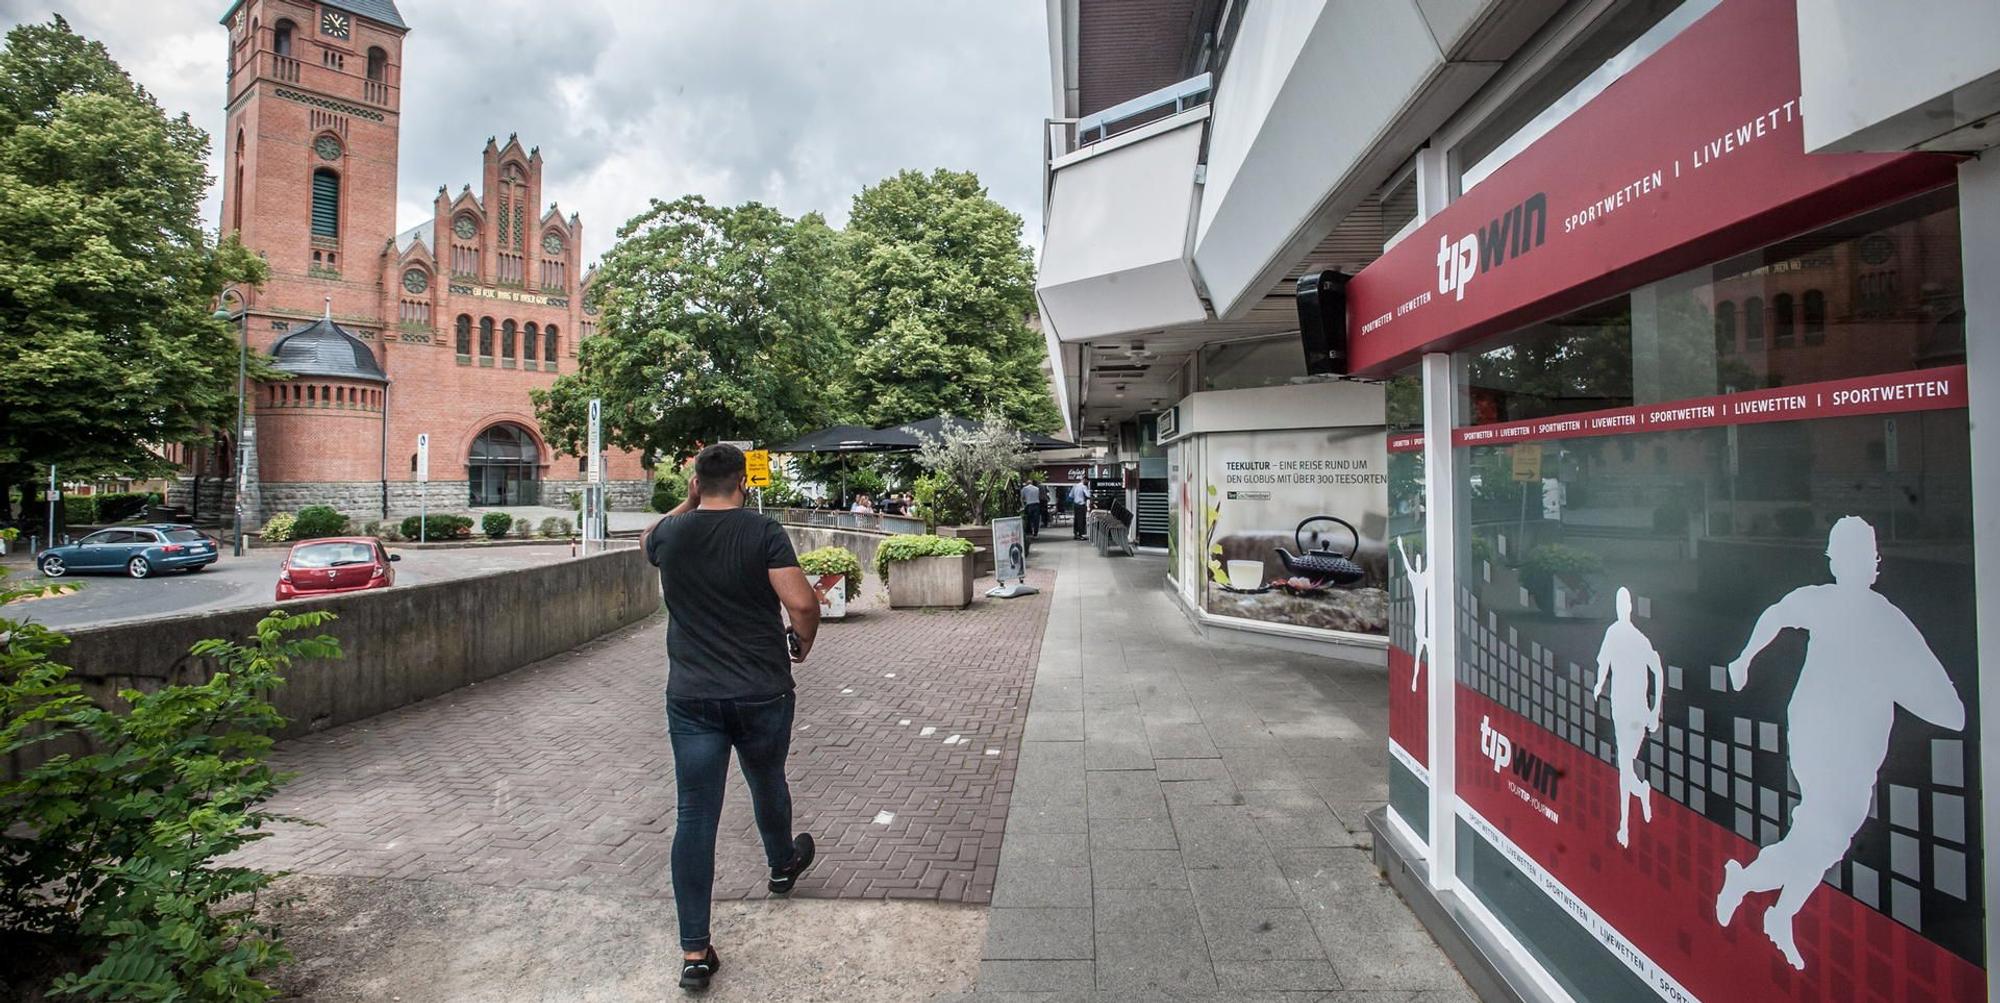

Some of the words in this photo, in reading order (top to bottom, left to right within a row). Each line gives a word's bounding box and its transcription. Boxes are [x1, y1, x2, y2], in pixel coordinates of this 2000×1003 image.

[1564, 170, 1662, 233] SPORTWETTEN
[1693, 97, 1803, 169] LIVEWETT
[1437, 192, 1546, 302] tipwin
[1463, 431, 1493, 441] SPORTWETTEN
[1500, 426, 1530, 437] LIVEWETTEN
[1539, 420, 1580, 433] SPORTWETTEN
[1592, 414, 1635, 428] LIVEWETTEN
[1650, 405, 1715, 423] SPORTWETTEN
[1735, 395, 1806, 415] LIVEWETTEN
[1833, 380, 1949, 406] SPORTWETTEN
[1226, 461, 1270, 470] TEEKULTUR
[1279, 461, 1297, 470] EINE
[1300, 460, 1323, 470] REISE
[1325, 460, 1350, 470] RUND
[1352, 460, 1367, 470] UM
[1226, 474, 1242, 484] DEN
[1243, 474, 1276, 484] GLOBUS
[1277, 474, 1292, 483] MIT
[1293, 472, 1316, 484] ÜBER
[1317, 474, 1334, 484] 300
[1336, 473, 1387, 484] TEESORTEN
[1480, 715, 1561, 800] tipwin
[1506, 845, 1537, 877] LIVEWETTEN
[1545, 878, 1588, 922] SPORTWETTEN
[1600, 926, 1645, 972] LIVEWETTEN
[1659, 977, 1692, 1003] SPORT
